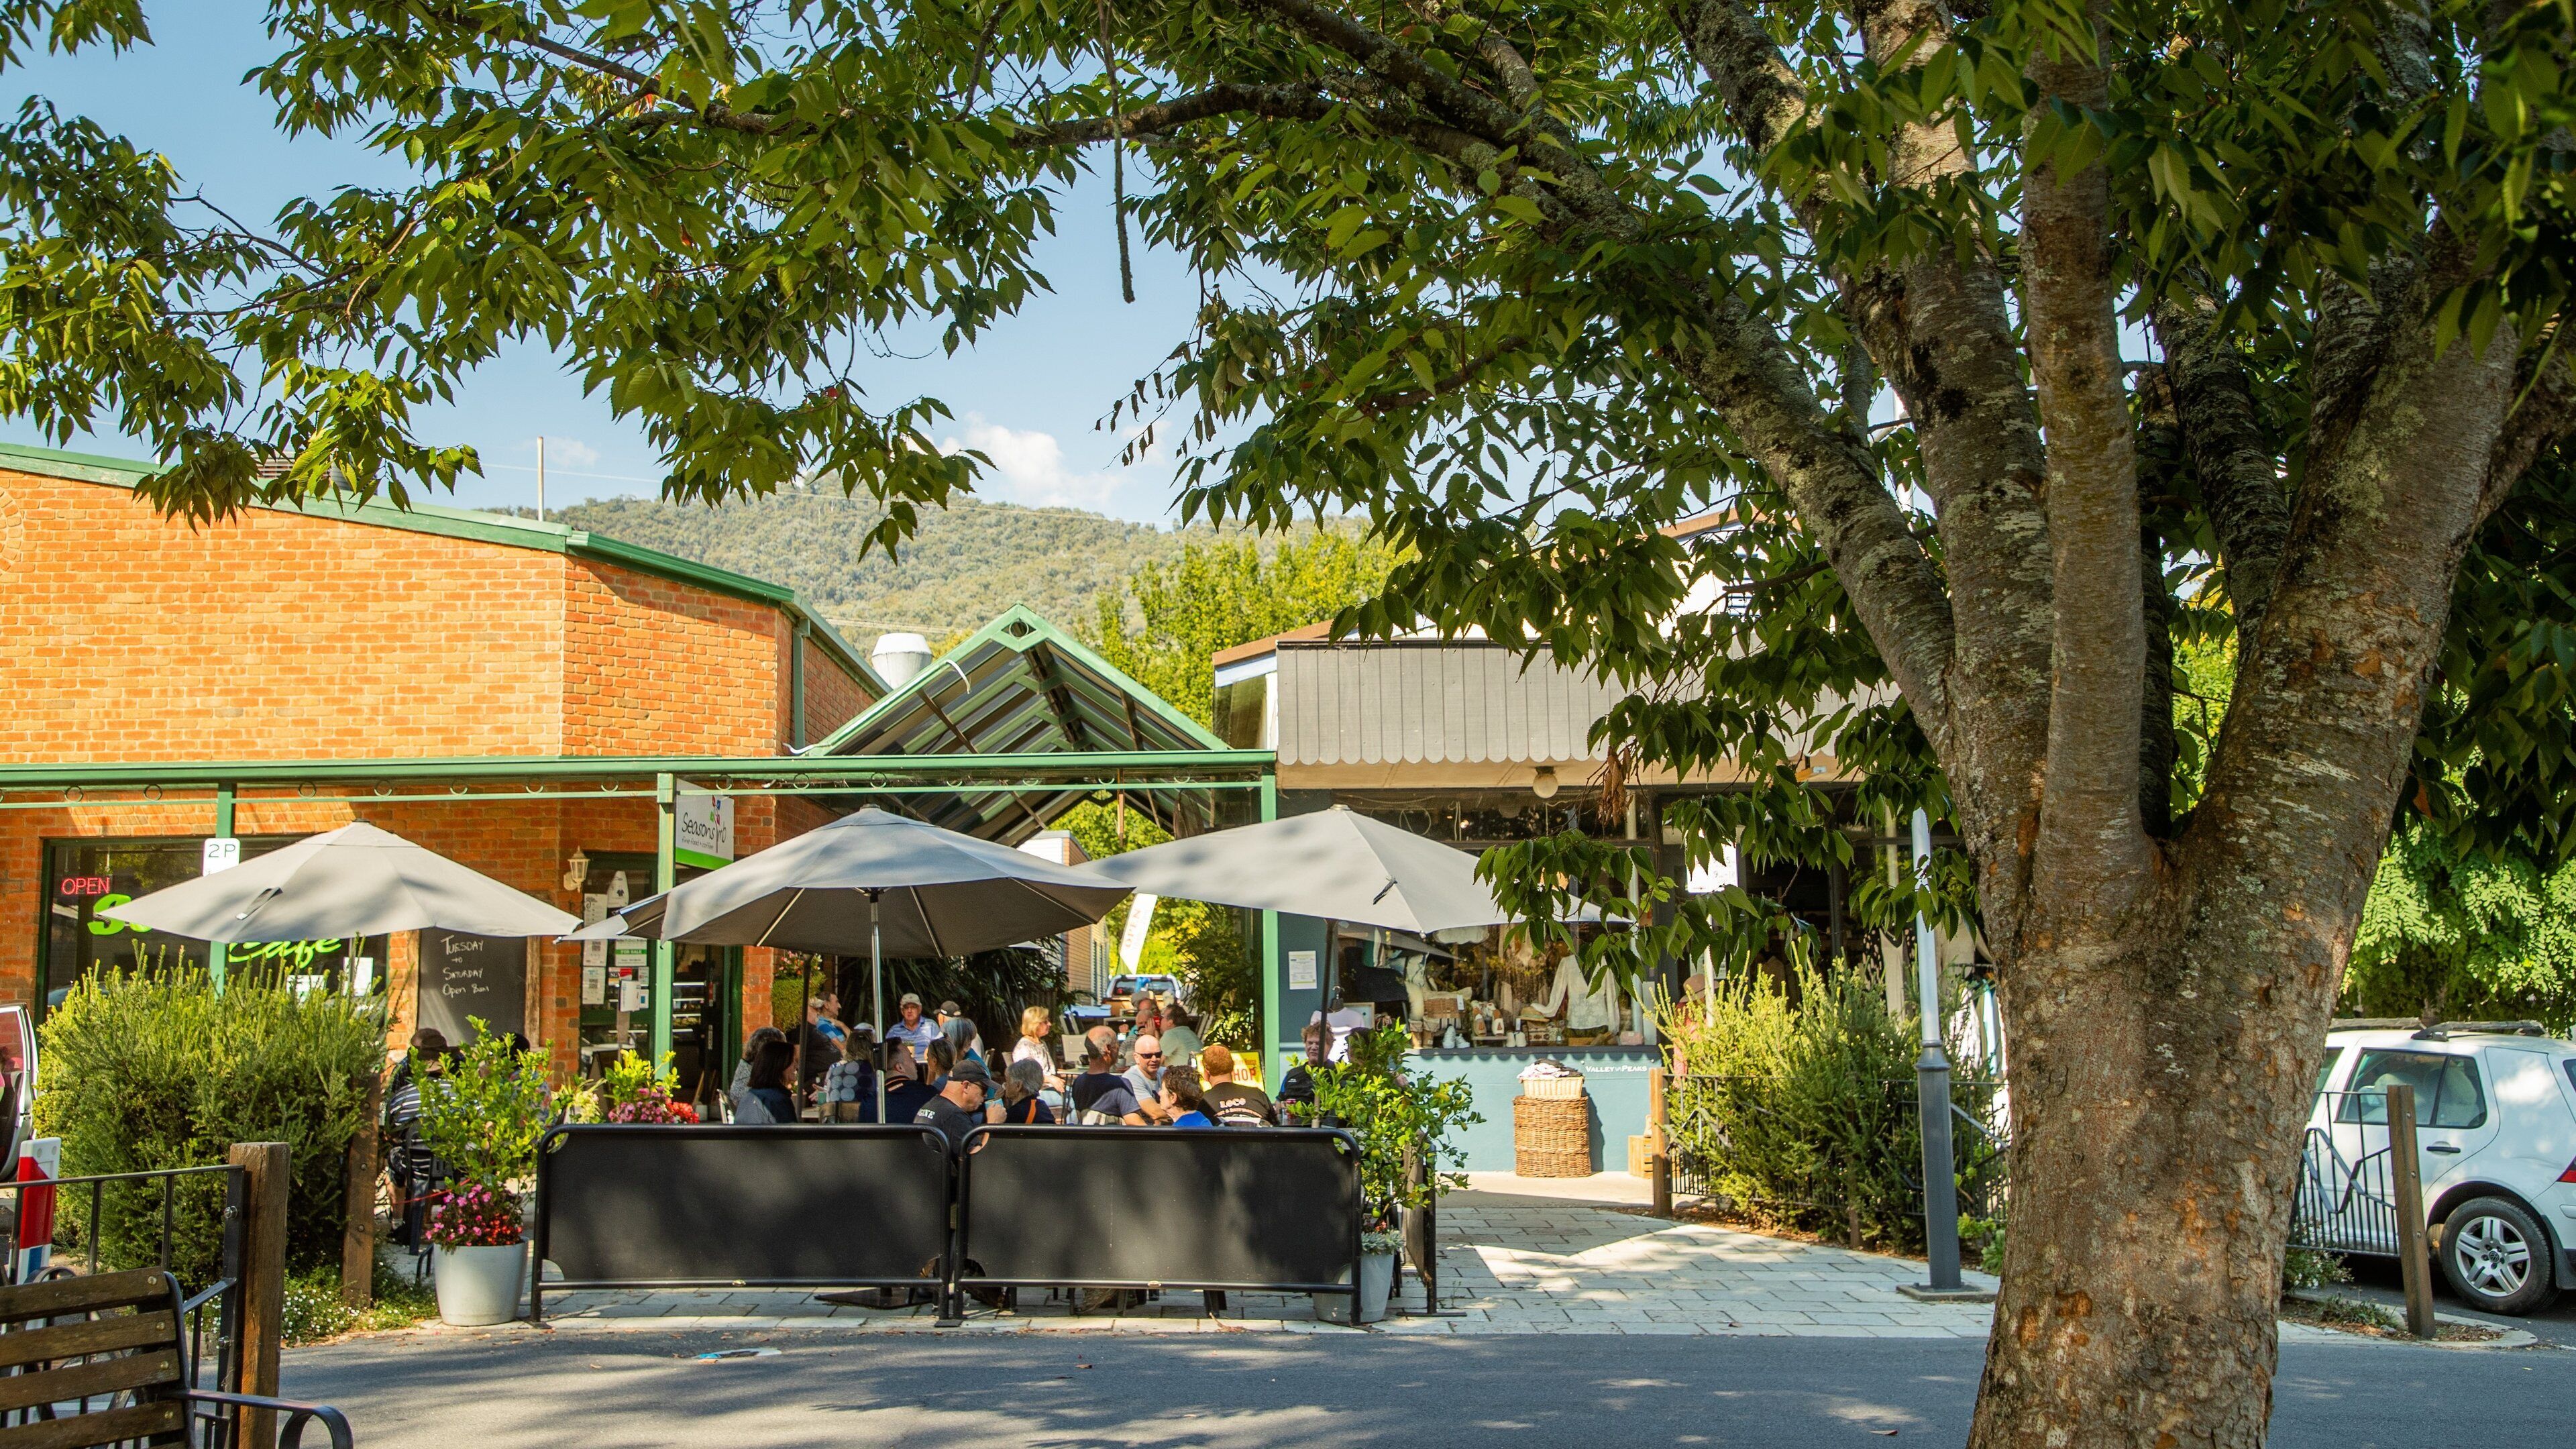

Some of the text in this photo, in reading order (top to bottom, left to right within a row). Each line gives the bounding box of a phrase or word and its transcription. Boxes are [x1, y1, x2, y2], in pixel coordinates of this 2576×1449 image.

[682, 812, 716, 840] Seasons
[61, 877, 110, 895] OPEN
[1125, 908, 1142, 949] OPEN
[442, 983, 467, 999] Open
[1233, 1067, 1256, 1081] HOP
[1220, 1097, 1246, 1108] LOCO
